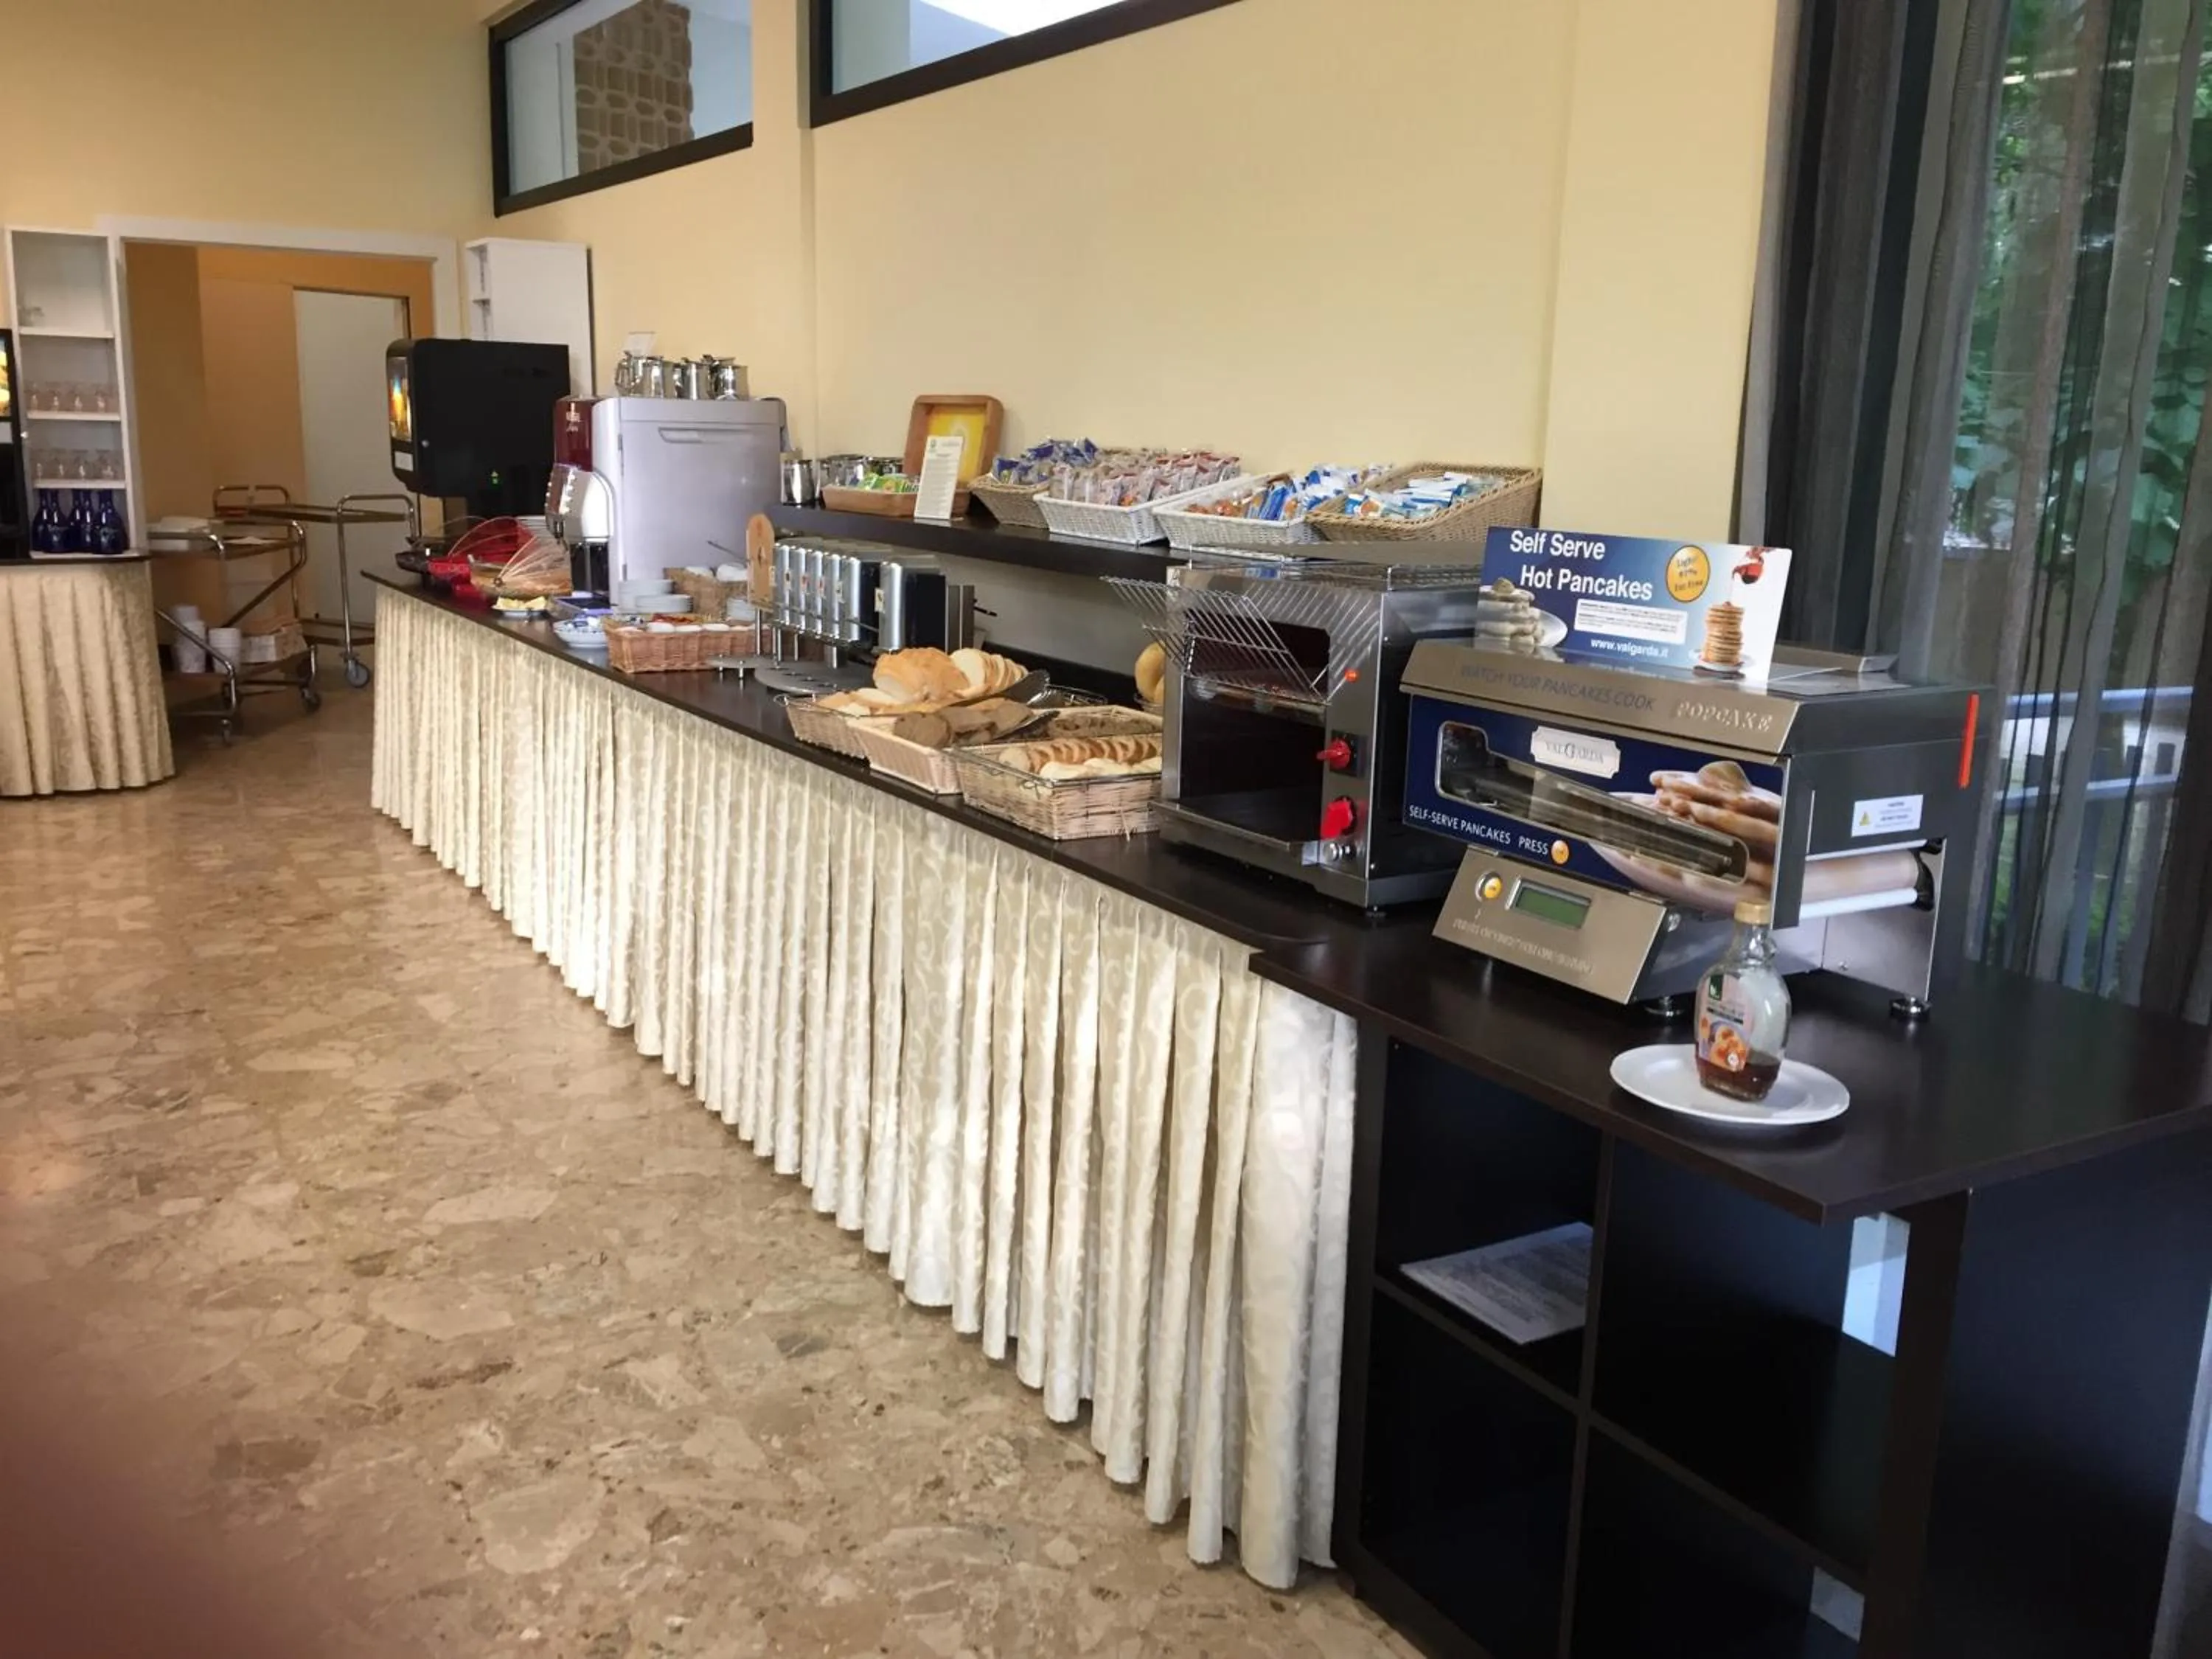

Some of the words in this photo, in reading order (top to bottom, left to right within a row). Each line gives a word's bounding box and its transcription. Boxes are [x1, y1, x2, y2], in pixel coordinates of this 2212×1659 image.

[1510, 530, 1547, 554] Self
[1550, 533, 1605, 560] Serve
[1520, 564, 1553, 589] Hot
[1557, 568, 1653, 600] Pancakes
[1590, 639, 1669, 658] www.valgarda.it
[1461, 665, 1503, 683] WATCH
[1508, 672, 1542, 690] YOUR
[1542, 678, 1610, 705] PANCAKES
[1614, 690, 1657, 711] COOK
[1409, 804, 1458, 830] SELF-SERVE
[1460, 820, 1512, 845] PANCAKES
[1517, 835, 1549, 855] PRESS
